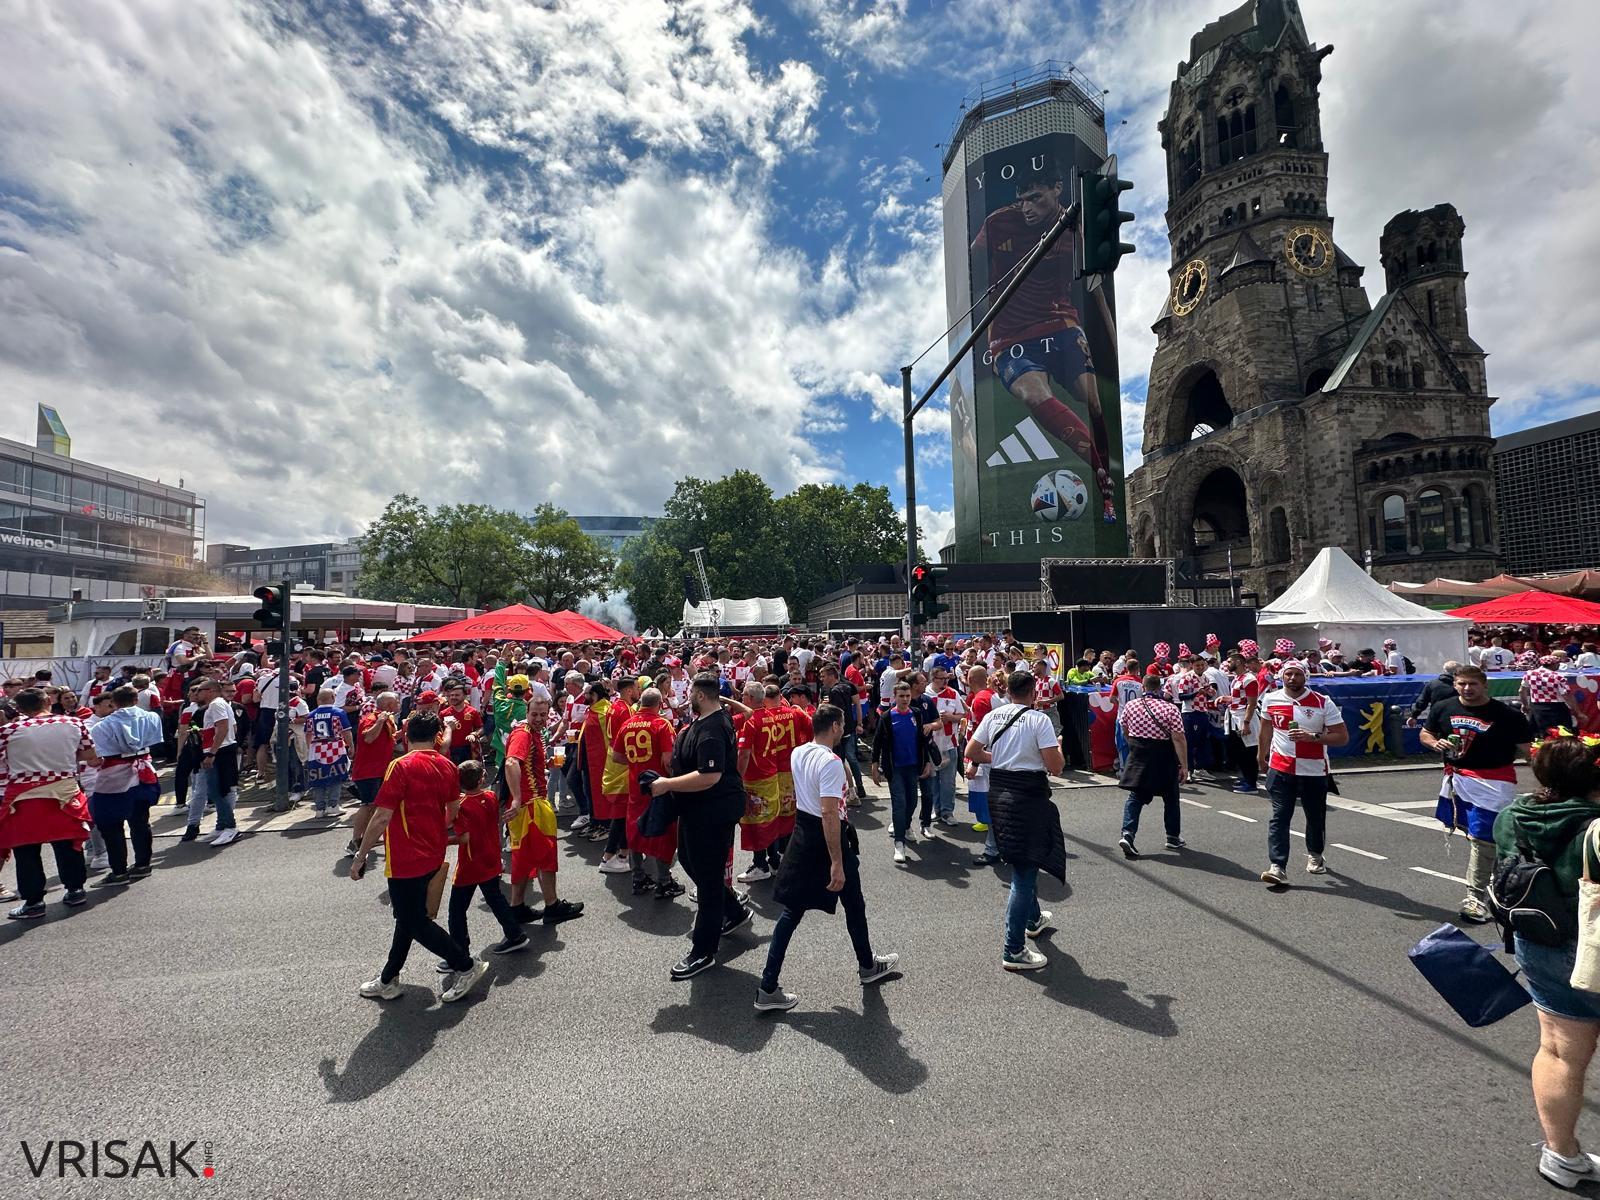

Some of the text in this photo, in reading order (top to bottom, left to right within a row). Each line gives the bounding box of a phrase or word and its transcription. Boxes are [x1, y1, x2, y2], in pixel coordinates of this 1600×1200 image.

[975, 154, 1045, 190] YOU
[982, 337, 1054, 365] GOT
[99, 506, 157, 529] SUPERFIT
[988, 526, 1063, 547] THIS
[1123, 688, 1137, 704] 10
[315, 720, 330, 738] 9
[1273, 714, 1285, 728] 17
[623, 729, 653, 763] 69
